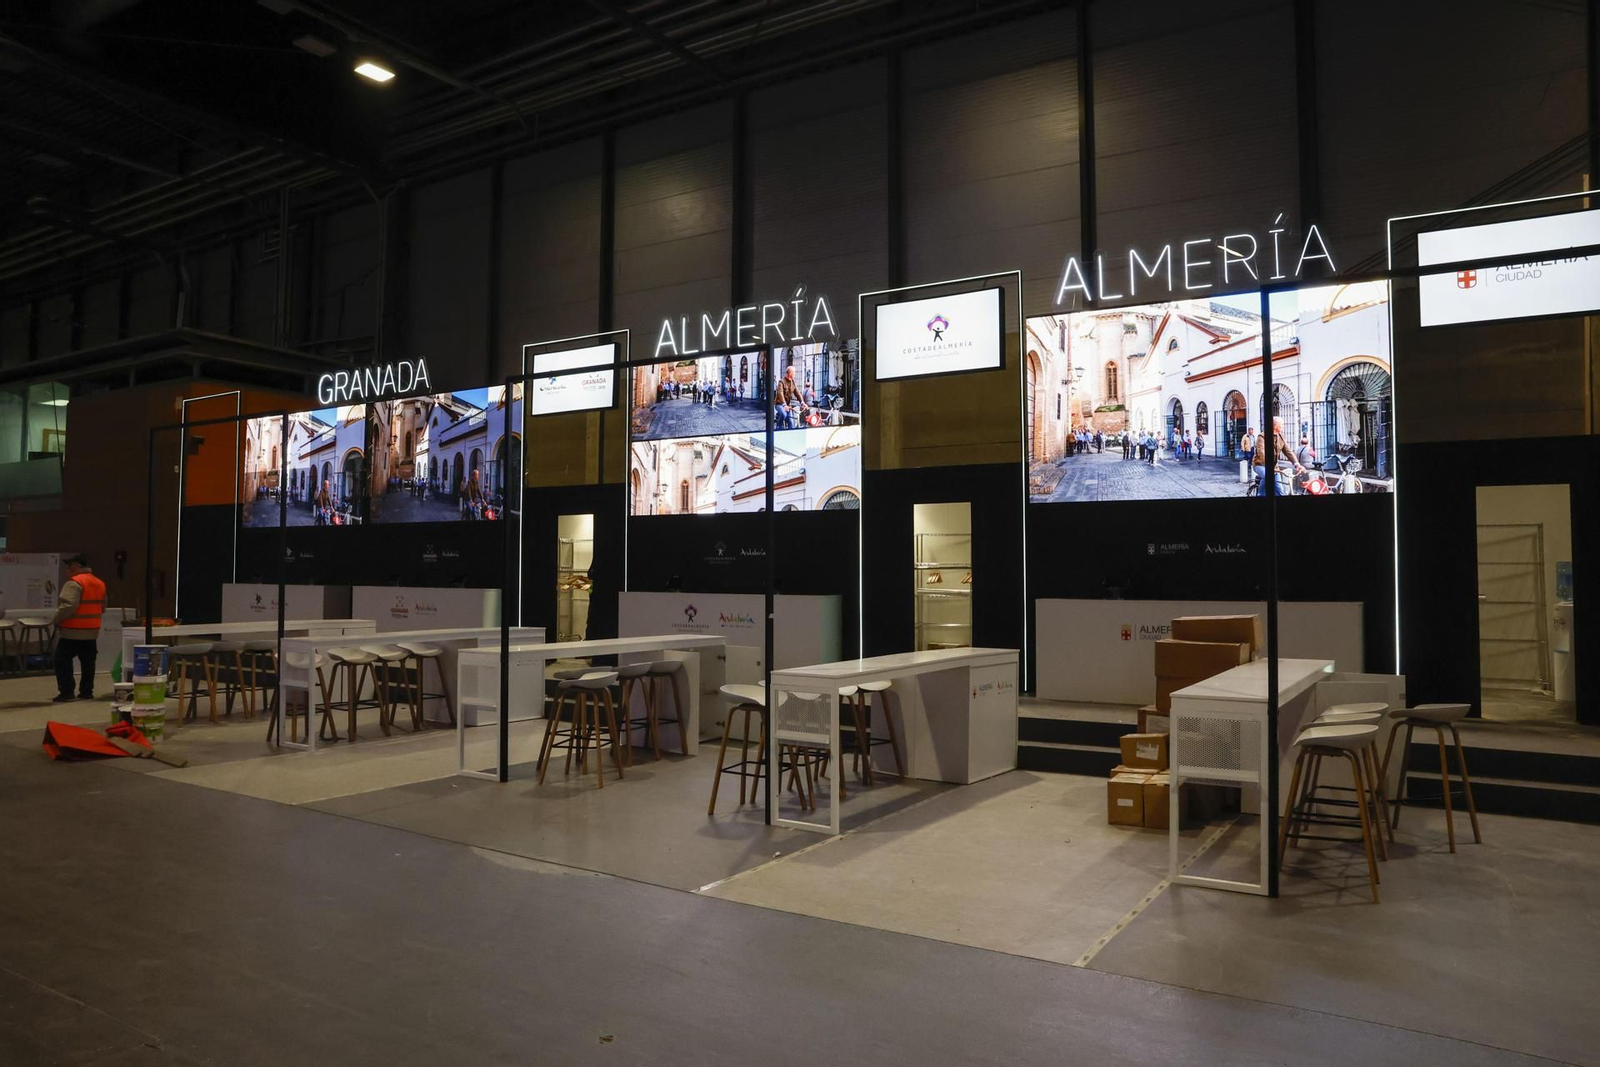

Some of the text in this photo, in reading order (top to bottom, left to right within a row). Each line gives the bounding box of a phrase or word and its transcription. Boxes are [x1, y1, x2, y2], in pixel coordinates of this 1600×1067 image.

[1057, 212, 1337, 305] ALMERÍA
[1495, 269, 1542, 283] CIUDAD
[654, 287, 836, 358] ALMERÍA
[317, 358, 430, 405] GRANADA
